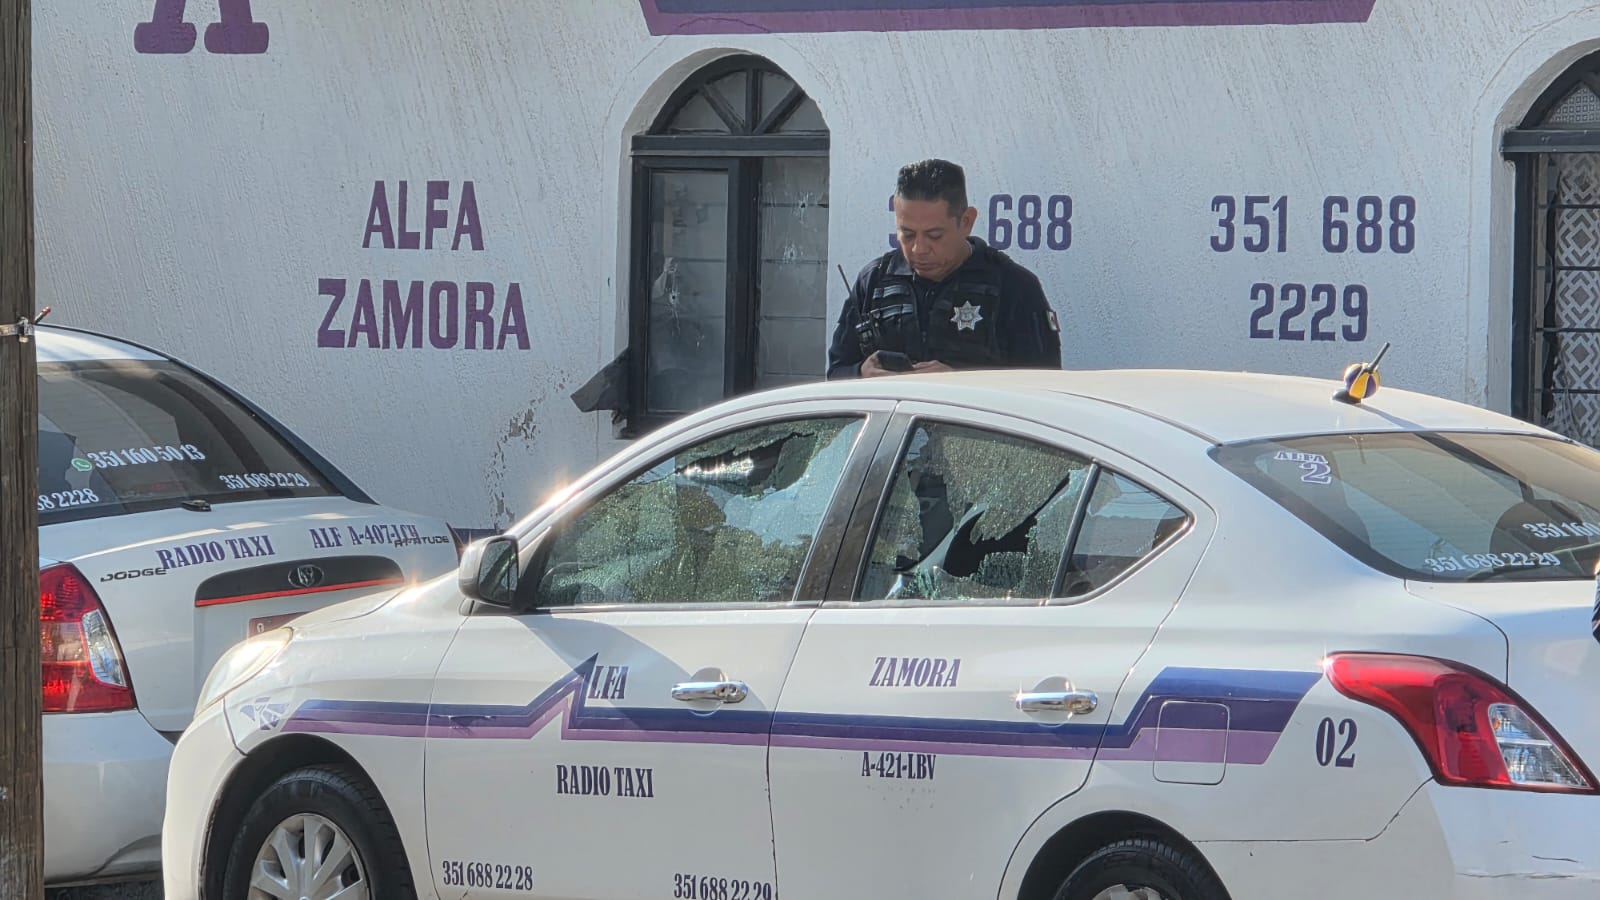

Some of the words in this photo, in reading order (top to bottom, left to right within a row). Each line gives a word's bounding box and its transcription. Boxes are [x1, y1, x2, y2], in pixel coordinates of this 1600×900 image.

[362, 180, 485, 251] ALFA
[988, 193, 1073, 251] 688
[1210, 195, 1288, 253] 351
[1322, 195, 1416, 254] 688
[317, 278, 531, 350] ZAMORA
[1249, 282, 1369, 342] 2229
[87, 450, 127, 469] 351
[120, 447, 158, 465] 160
[153, 445, 184, 462] 50
[180, 443, 206, 461] 13
[219, 473, 250, 490] 351
[243, 472, 276, 488] 688
[1299, 461, 1333, 485] 2
[309, 526, 344, 549] ALF
[1522, 522, 1571, 539] 351
[156, 541, 226, 570] RADIO
[225, 535, 276, 559] TAXI
[1425, 556, 1467, 573] 351
[1461, 553, 1505, 569] 688
[100, 567, 167, 583] DODGE
[869, 656, 962, 688] ZAMORA
[1316, 716, 1358, 768] 02
[861, 751, 937, 780] A-421-LBV
[556, 764, 611, 796] RADIO
[614, 767, 655, 798] TAXI
[442, 860, 465, 886] 351
[466, 862, 493, 889] 688
[673, 873, 697, 900] 351
[699, 876, 728, 900] 688
